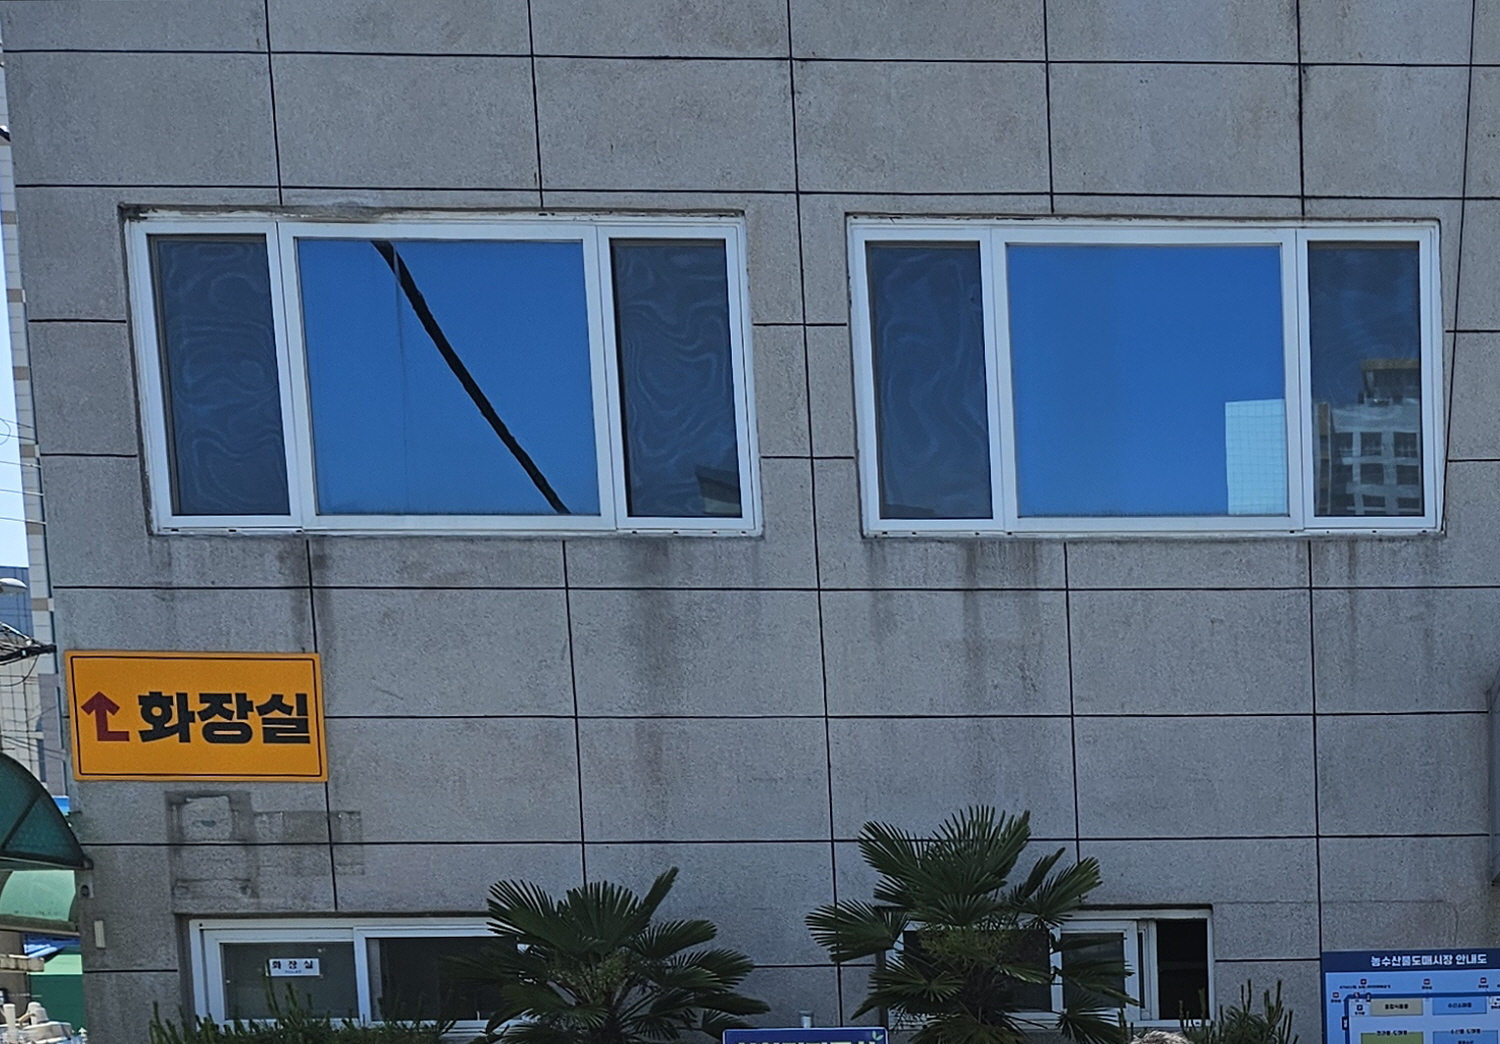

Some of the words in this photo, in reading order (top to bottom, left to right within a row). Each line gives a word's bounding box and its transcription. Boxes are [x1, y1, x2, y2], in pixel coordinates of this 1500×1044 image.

[137, 691, 311, 744] 화장실
[1371, 954, 1453, 967] 농수산물도매시장
[1455, 954, 1487, 965] 안내도
